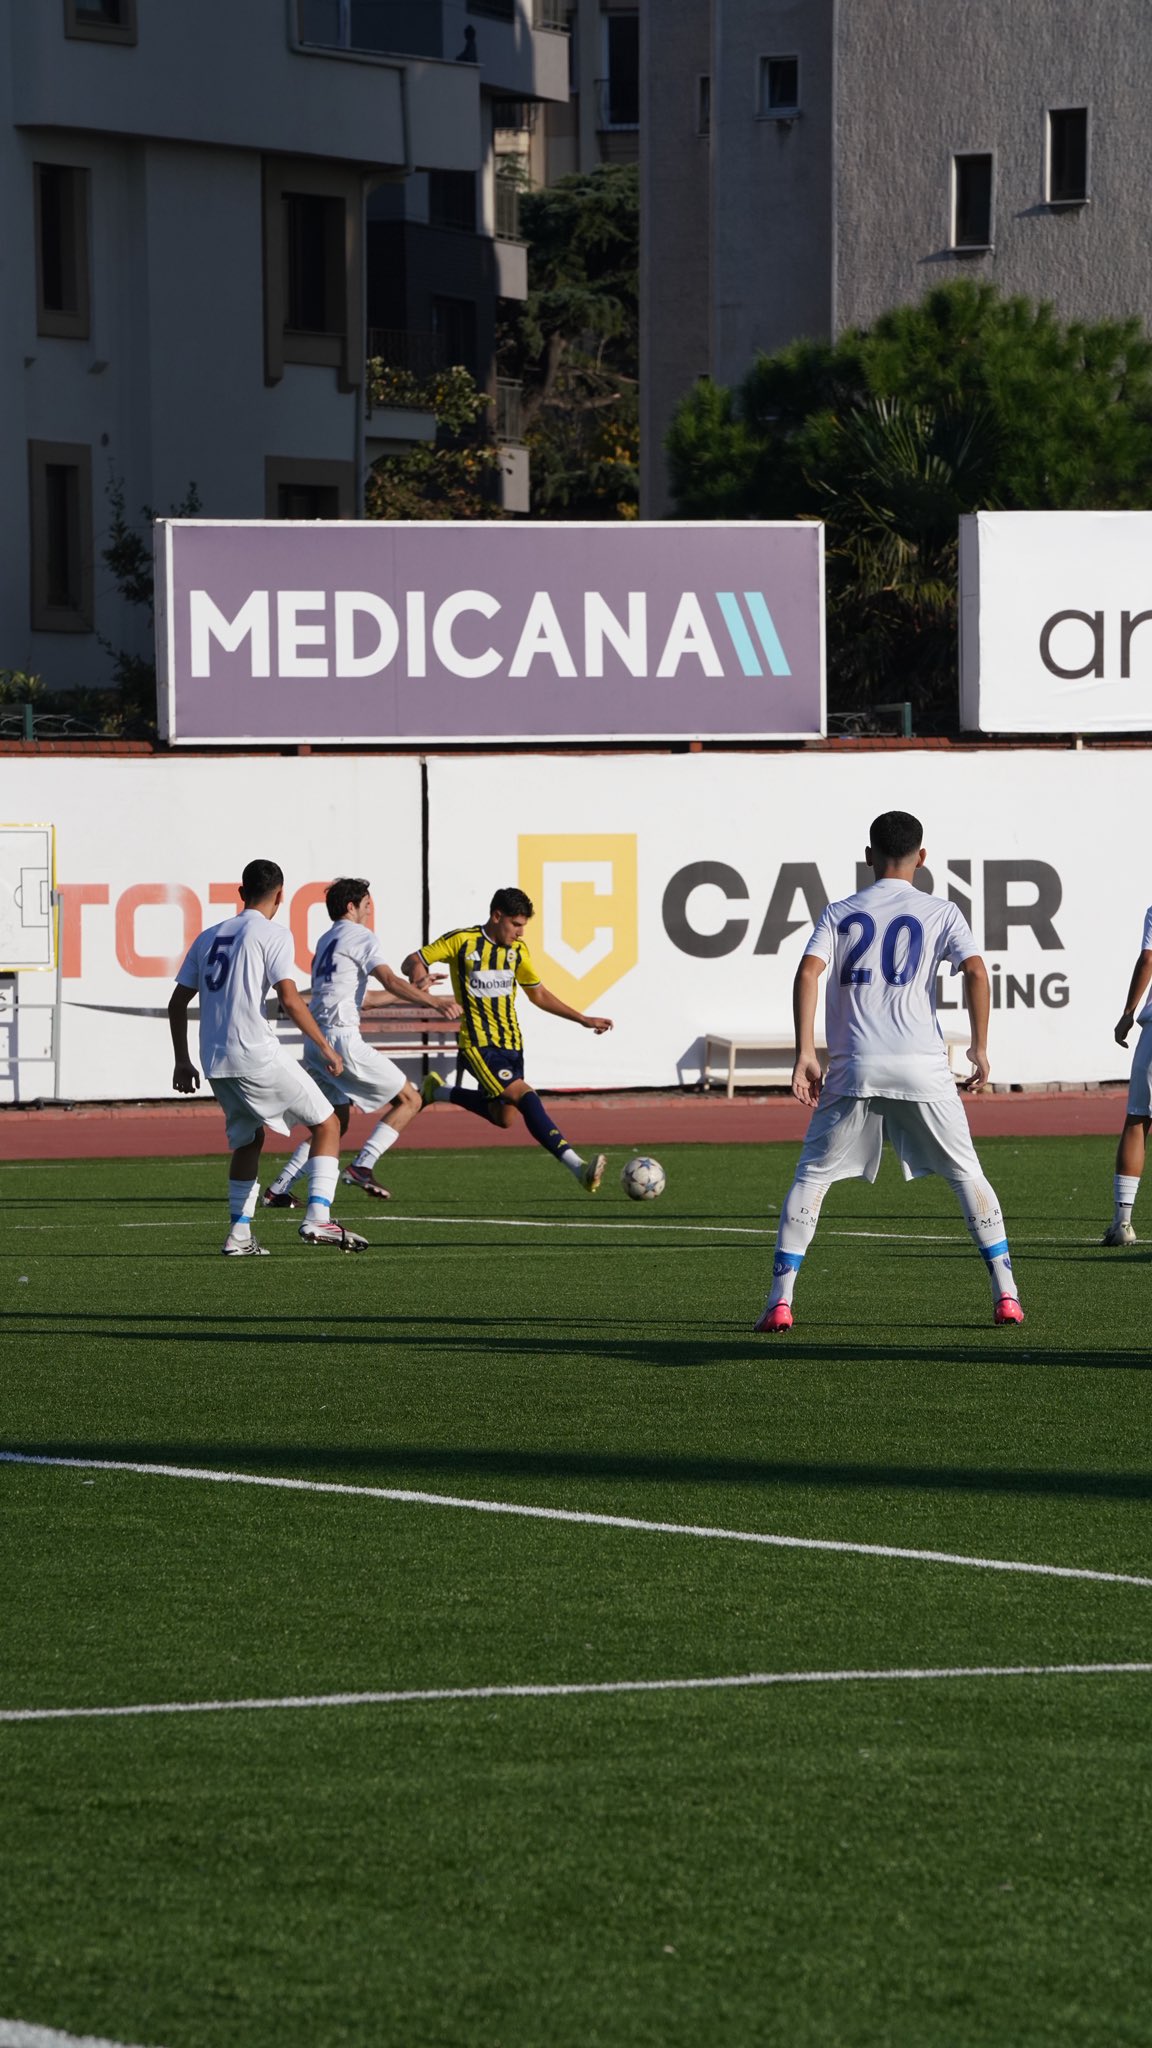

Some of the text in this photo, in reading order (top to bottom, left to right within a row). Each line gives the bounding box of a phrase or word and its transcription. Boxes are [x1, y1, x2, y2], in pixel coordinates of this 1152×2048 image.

[190, 590, 725, 678] MEDICANA
[57, 882, 375, 978] TOO
[662, 859, 1065, 959] CAİR
[837, 911, 925, 987] 20
[205, 936, 236, 992] 5
[316, 938, 338, 983] 4
